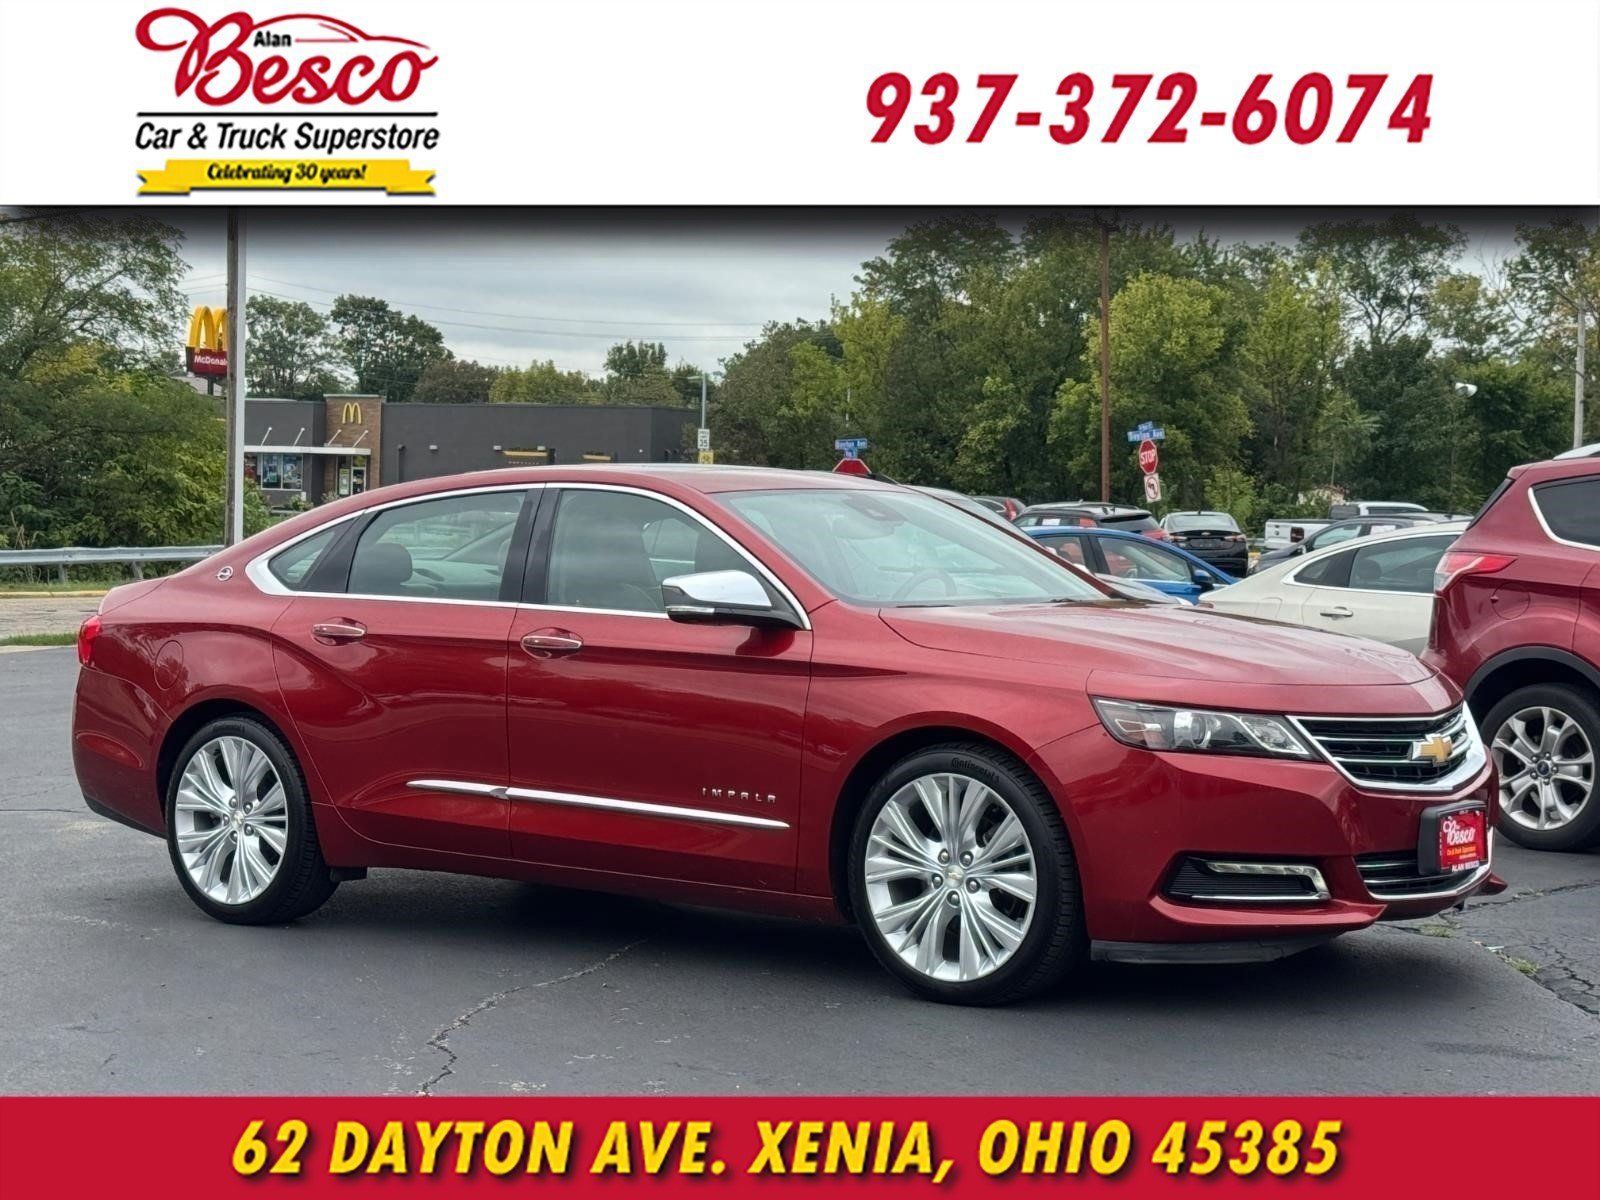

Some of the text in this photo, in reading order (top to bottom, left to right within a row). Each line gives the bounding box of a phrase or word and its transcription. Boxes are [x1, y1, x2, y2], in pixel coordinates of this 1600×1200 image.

[1141, 449, 1156, 465] STOP
[702, 787, 776, 803] IMPALA
[1443, 820, 1476, 846] Besco
